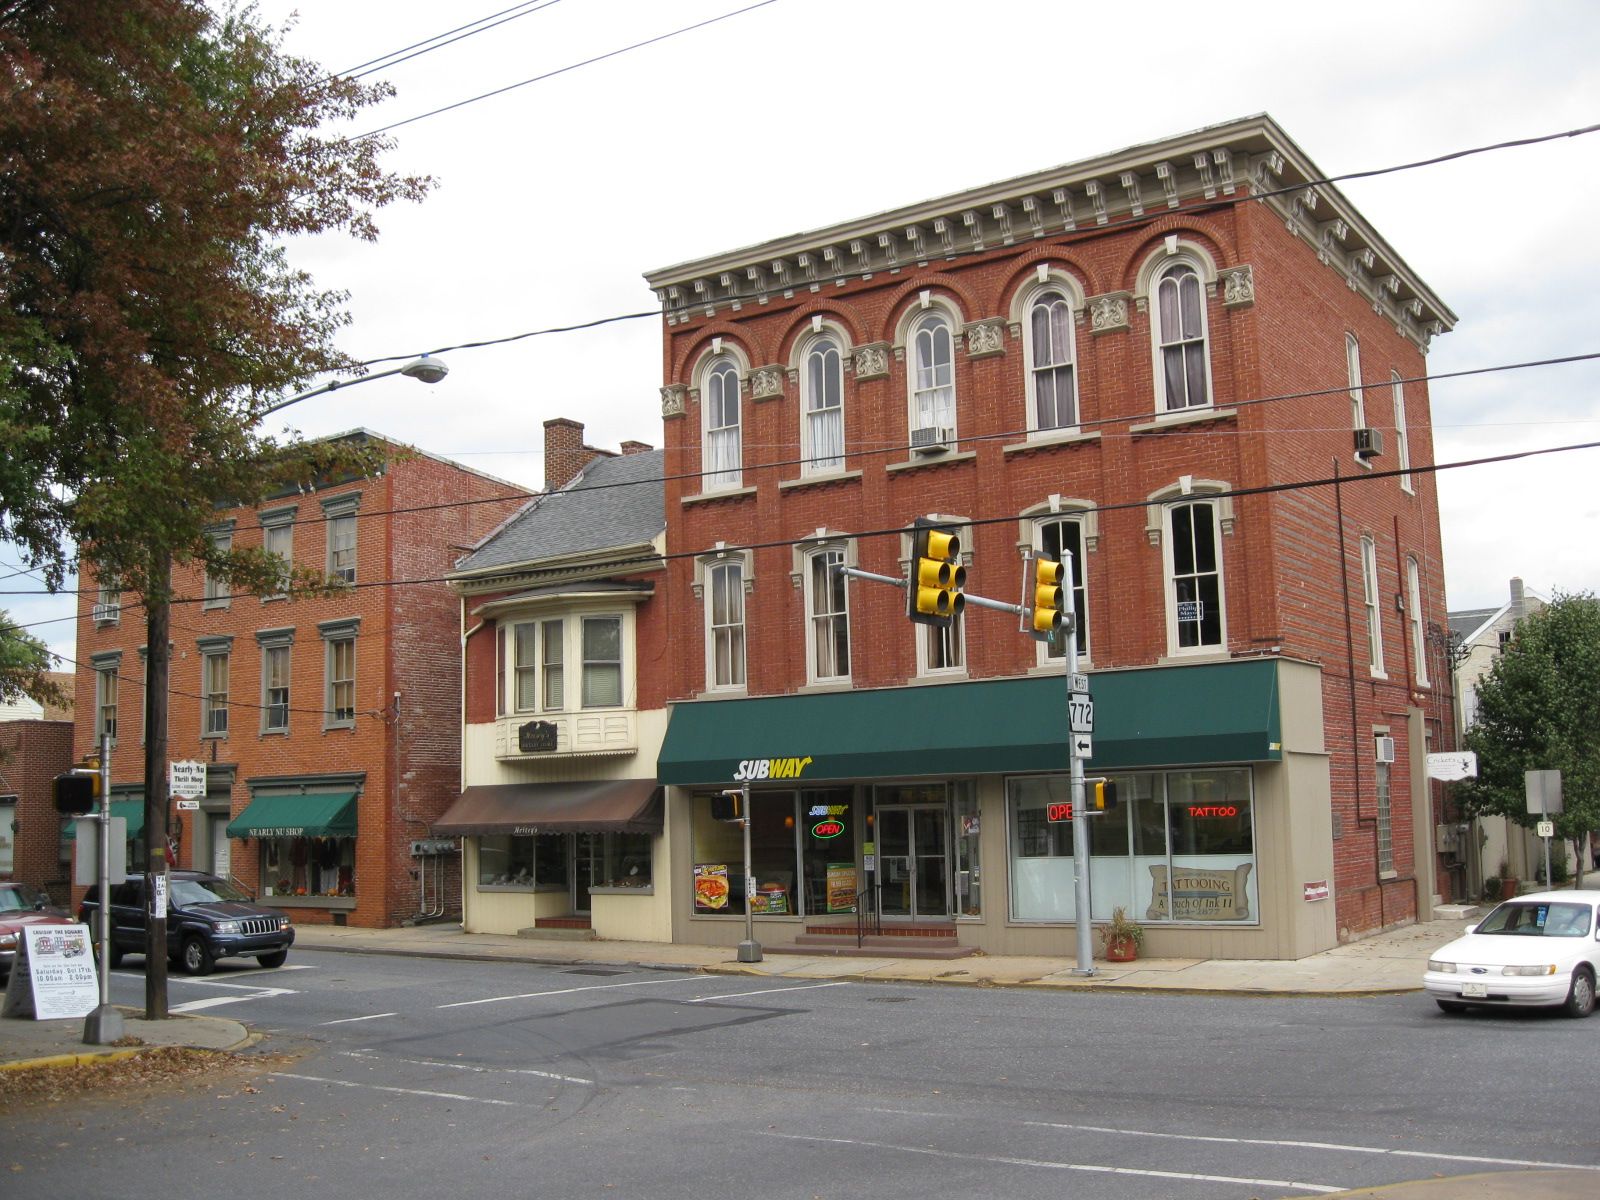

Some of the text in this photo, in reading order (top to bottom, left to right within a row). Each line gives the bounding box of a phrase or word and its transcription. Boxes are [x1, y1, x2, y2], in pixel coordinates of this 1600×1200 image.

[1075, 677, 1087, 690] WEST
[1070, 702, 1092, 725] 772
[733, 756, 813, 780] SUBWAY
[191, 776, 204, 784] Shop
[809, 805, 849, 816] SUBWAY
[1187, 806, 1237, 817] TATTOO
[249, 827, 304, 836] NEARLY NU SHOP
[816, 823, 840, 835] OPEN
[1158, 899, 1165, 909] A
[1205, 897, 1219, 908] Ink
